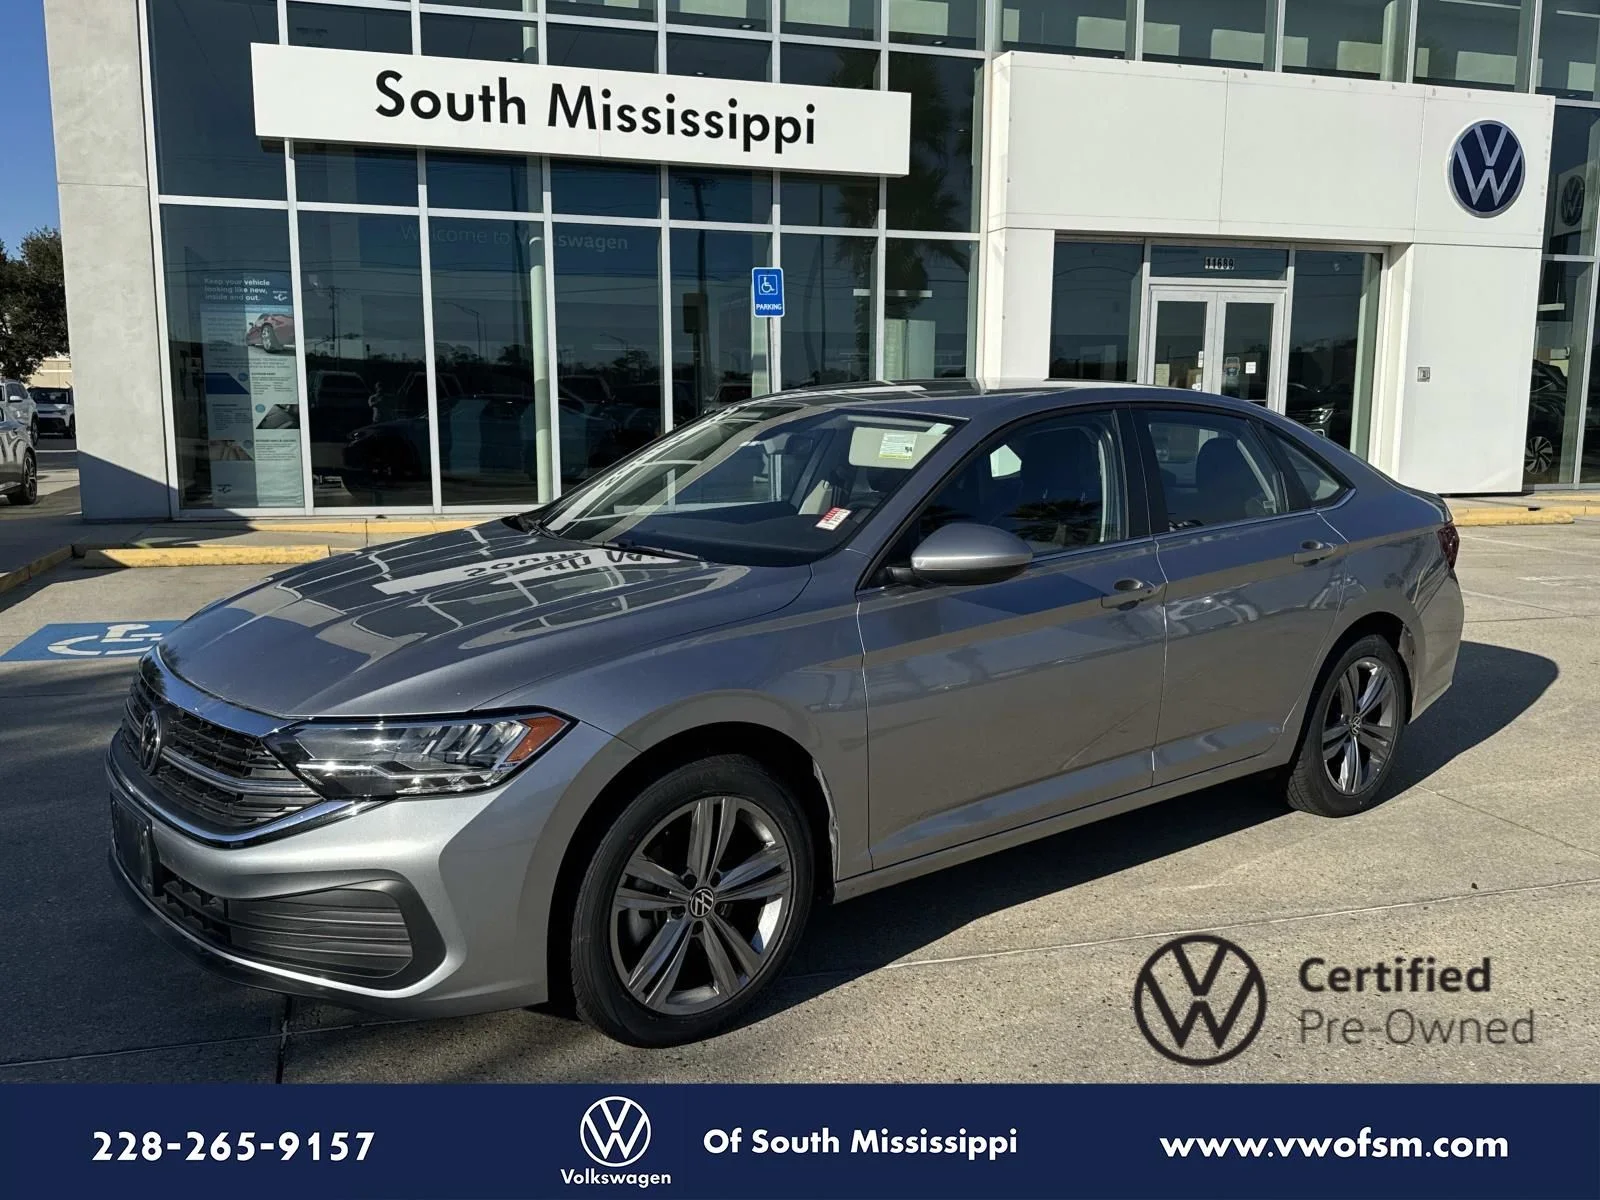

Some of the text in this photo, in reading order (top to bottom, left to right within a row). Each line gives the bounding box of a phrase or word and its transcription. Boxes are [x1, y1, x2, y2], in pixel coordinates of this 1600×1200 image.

[375, 69, 816, 154] South Mississippi
[400, 223, 629, 253] Wlcome to Vswagen
[755, 303, 782, 311] PARKING
